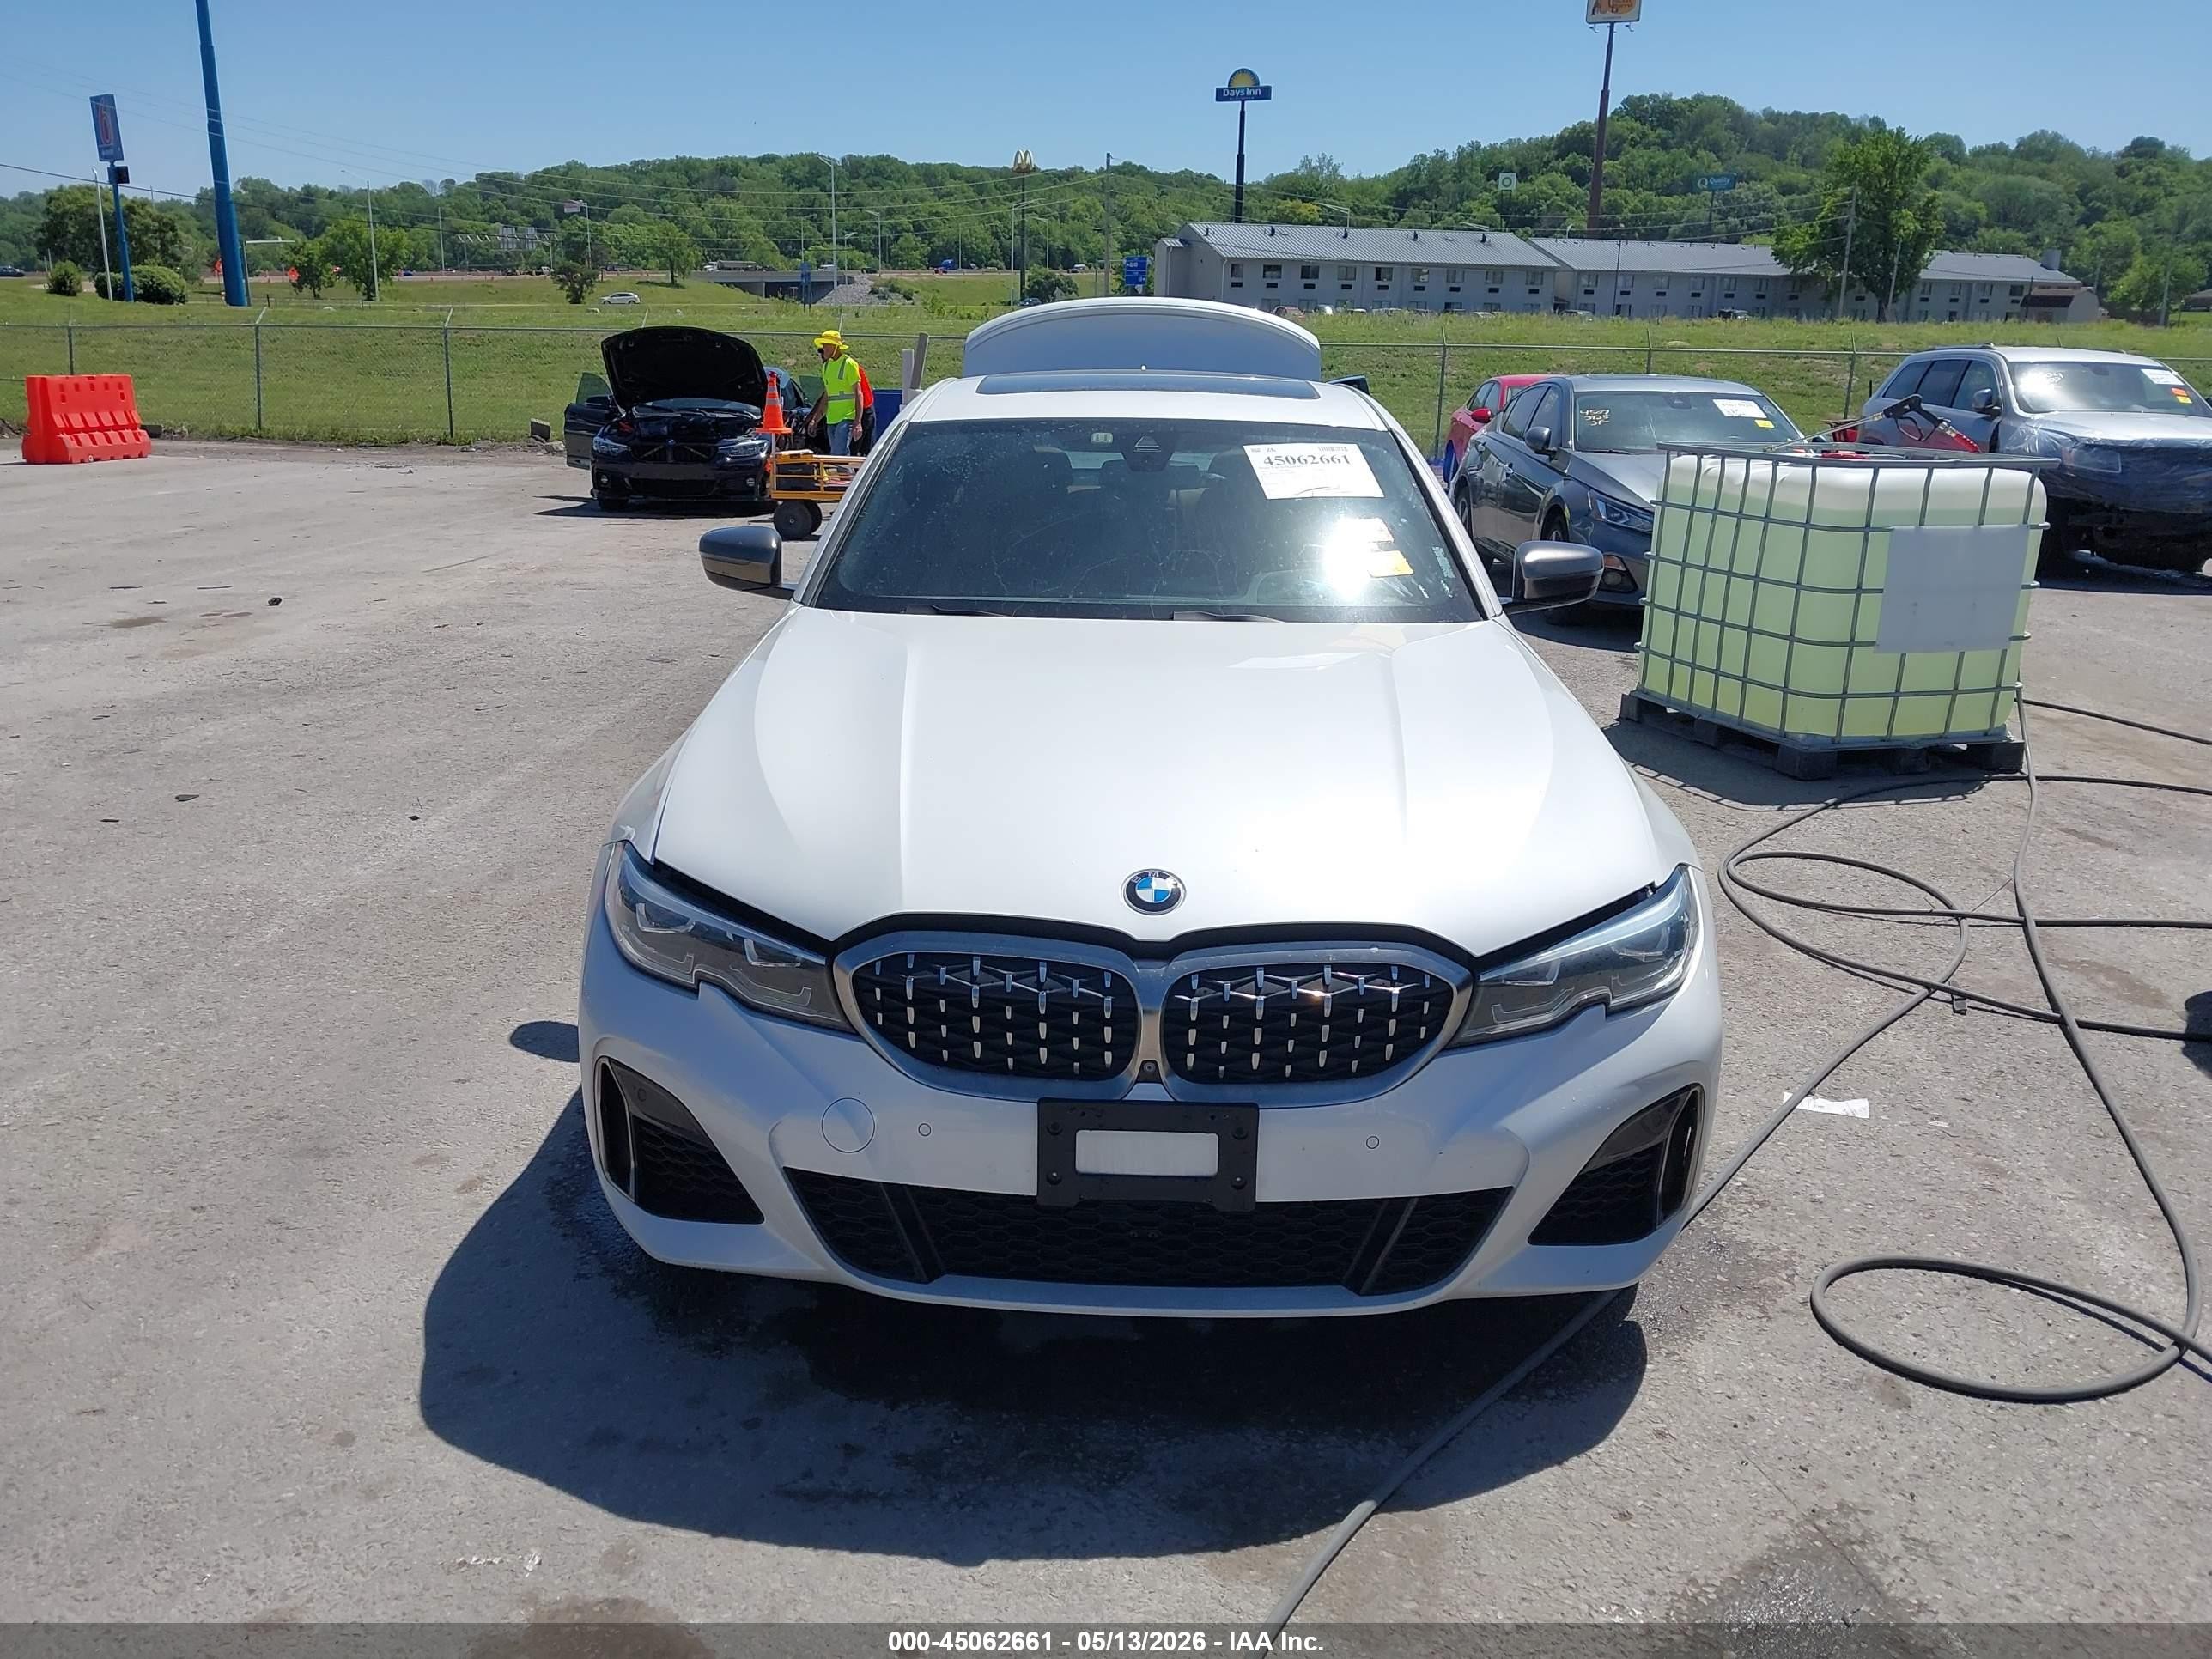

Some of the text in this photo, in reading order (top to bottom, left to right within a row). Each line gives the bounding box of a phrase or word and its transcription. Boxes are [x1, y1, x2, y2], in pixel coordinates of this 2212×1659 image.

[1223, 88, 1261, 97] Days Inn
[1263, 454, 1352, 466] 45062661
